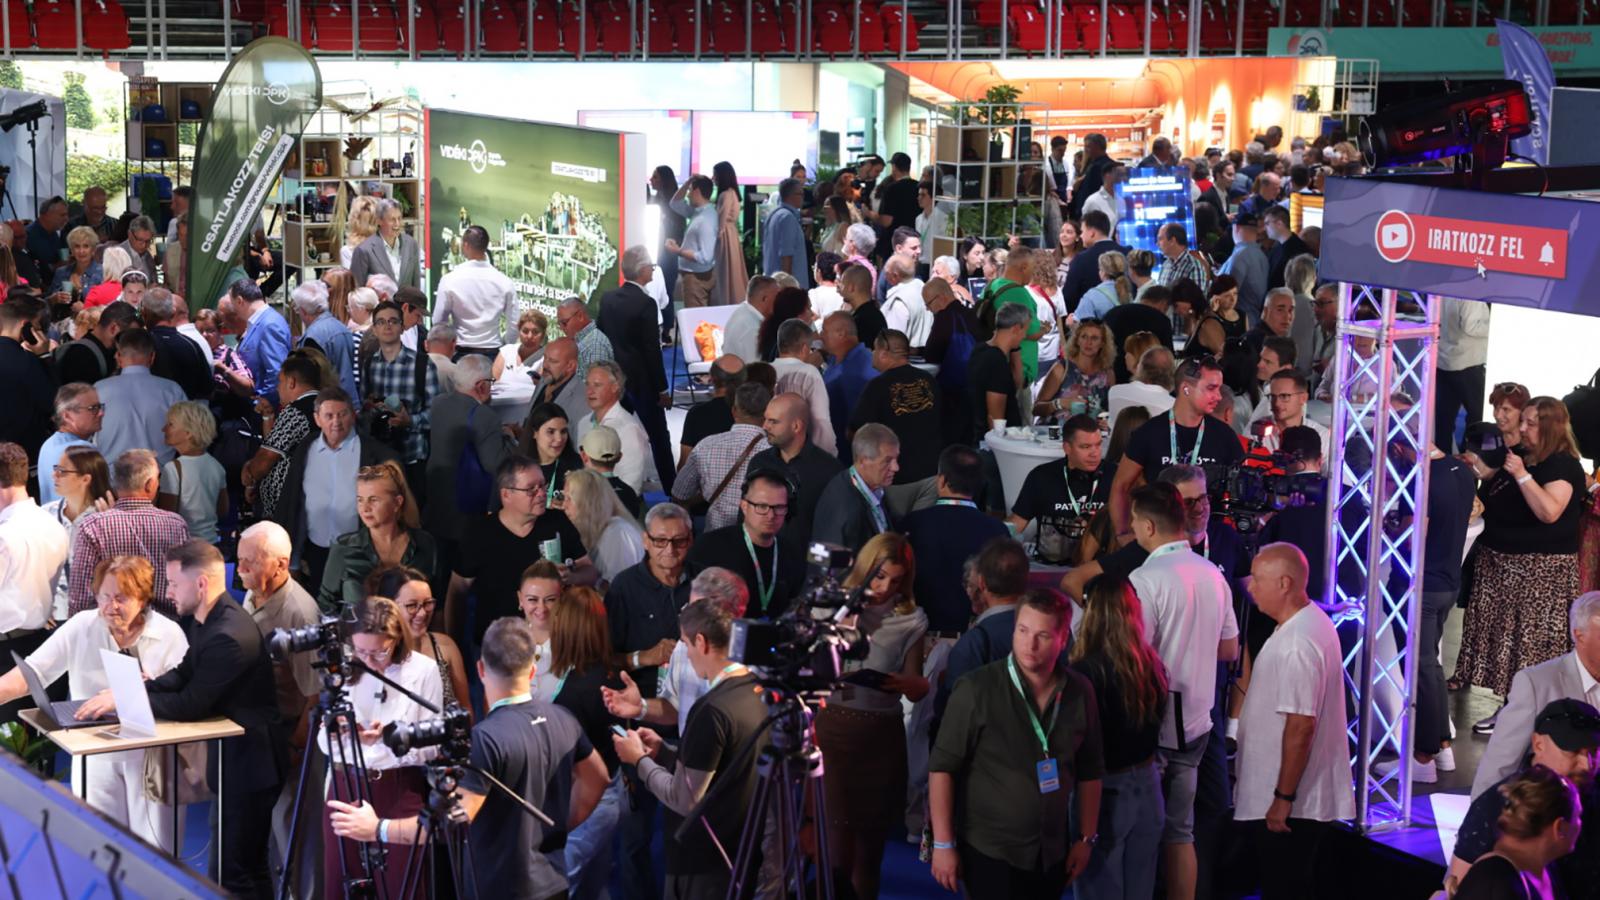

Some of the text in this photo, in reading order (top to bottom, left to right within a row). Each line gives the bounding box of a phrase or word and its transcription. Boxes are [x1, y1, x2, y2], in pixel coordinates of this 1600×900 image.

[201, 159, 257, 253] CSATLAKOZZ
[1427, 228, 1525, 259] IRATKOZZ FEL
